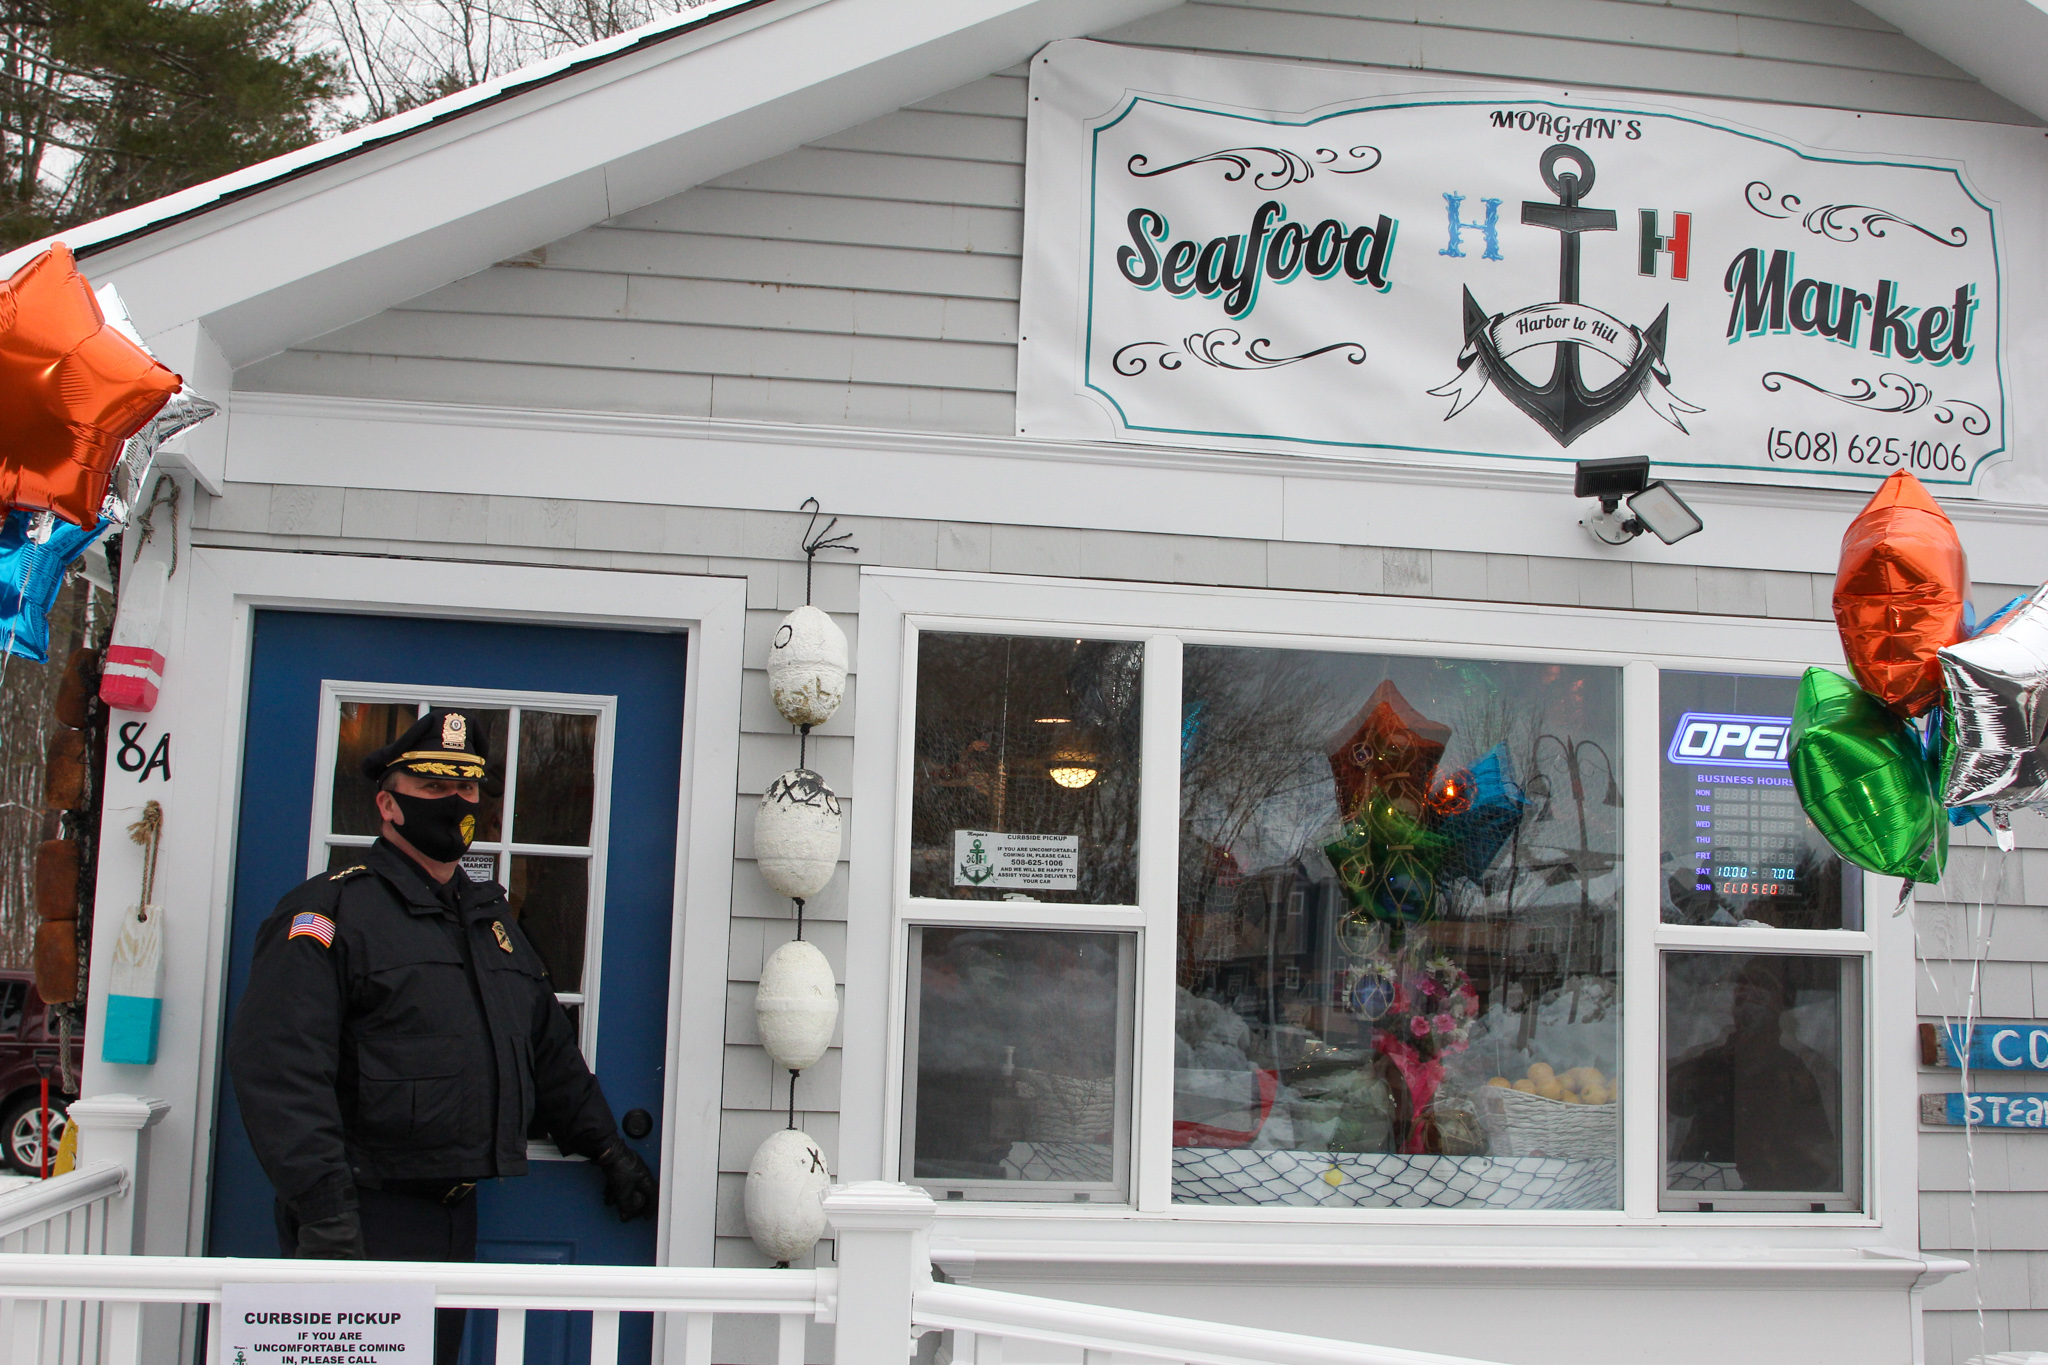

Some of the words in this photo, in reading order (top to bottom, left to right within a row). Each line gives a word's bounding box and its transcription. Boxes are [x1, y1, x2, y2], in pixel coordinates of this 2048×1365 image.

[1489, 110, 1642, 143] MORGAN'S
[1116, 200, 1399, 321] Seafood
[1724, 247, 1980, 367] Market
[1516, 315, 1570, 335] Harbor
[1573, 316, 1588, 332] to
[1591, 319, 1619, 344] Hill
[1767, 427, 1838, 465] (508)
[1848, 434, 1966, 472] 625-1006
[116, 720, 172, 783] 8A
[1697, 774, 1754, 785] BUSINESS
[1695, 788, 1711, 796] MON
[1695, 805, 1710, 813] TUE
[1695, 820, 1710, 828] WED
[1695, 836, 1710, 844] THU
[1695, 852, 1711, 860] FRI
[1695, 883, 1711, 891] SUN
[244, 1312, 332, 1325] CURBSIDE
[337, 1312, 402, 1325] PICKUP
[298, 1332, 308, 1340] IF
[312, 1332, 336, 1340] YOU
[339, 1332, 362, 1340] ARE
[254, 1344, 356, 1352] UNCOMFORTABLE
[359, 1344, 406, 1352] COMING
[301, 1356, 345, 1364] PLEASE
[348, 1356, 377, 1364] CALL
